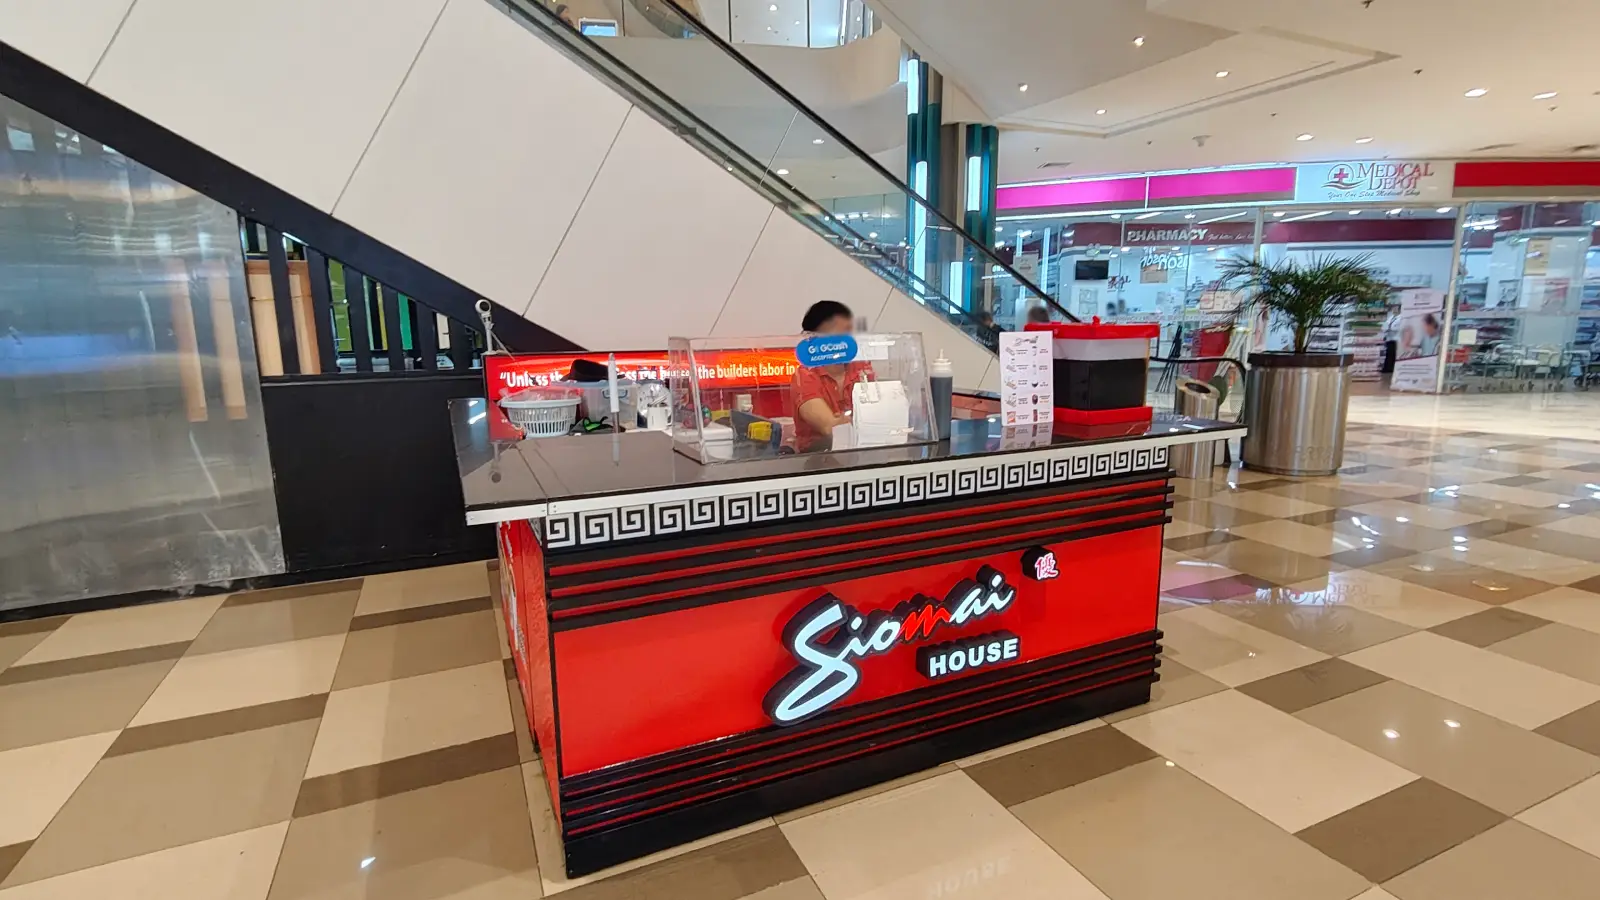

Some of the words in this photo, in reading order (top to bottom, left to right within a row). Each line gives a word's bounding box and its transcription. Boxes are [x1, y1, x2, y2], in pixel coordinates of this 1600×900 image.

[1356, 162, 1435, 179] MEDICAL
[1366, 175, 1420, 191] DEPOT
[1127, 228, 1208, 242] PHARMACY
[820, 341, 848, 353] GCash
[697, 364, 716, 380] the
[716, 363, 758, 379] builders
[759, 362, 784, 377] labor
[785, 361, 796, 377] in
[775, 574, 1014, 721] Siomai
[929, 637, 1019, 678] HOUSE
